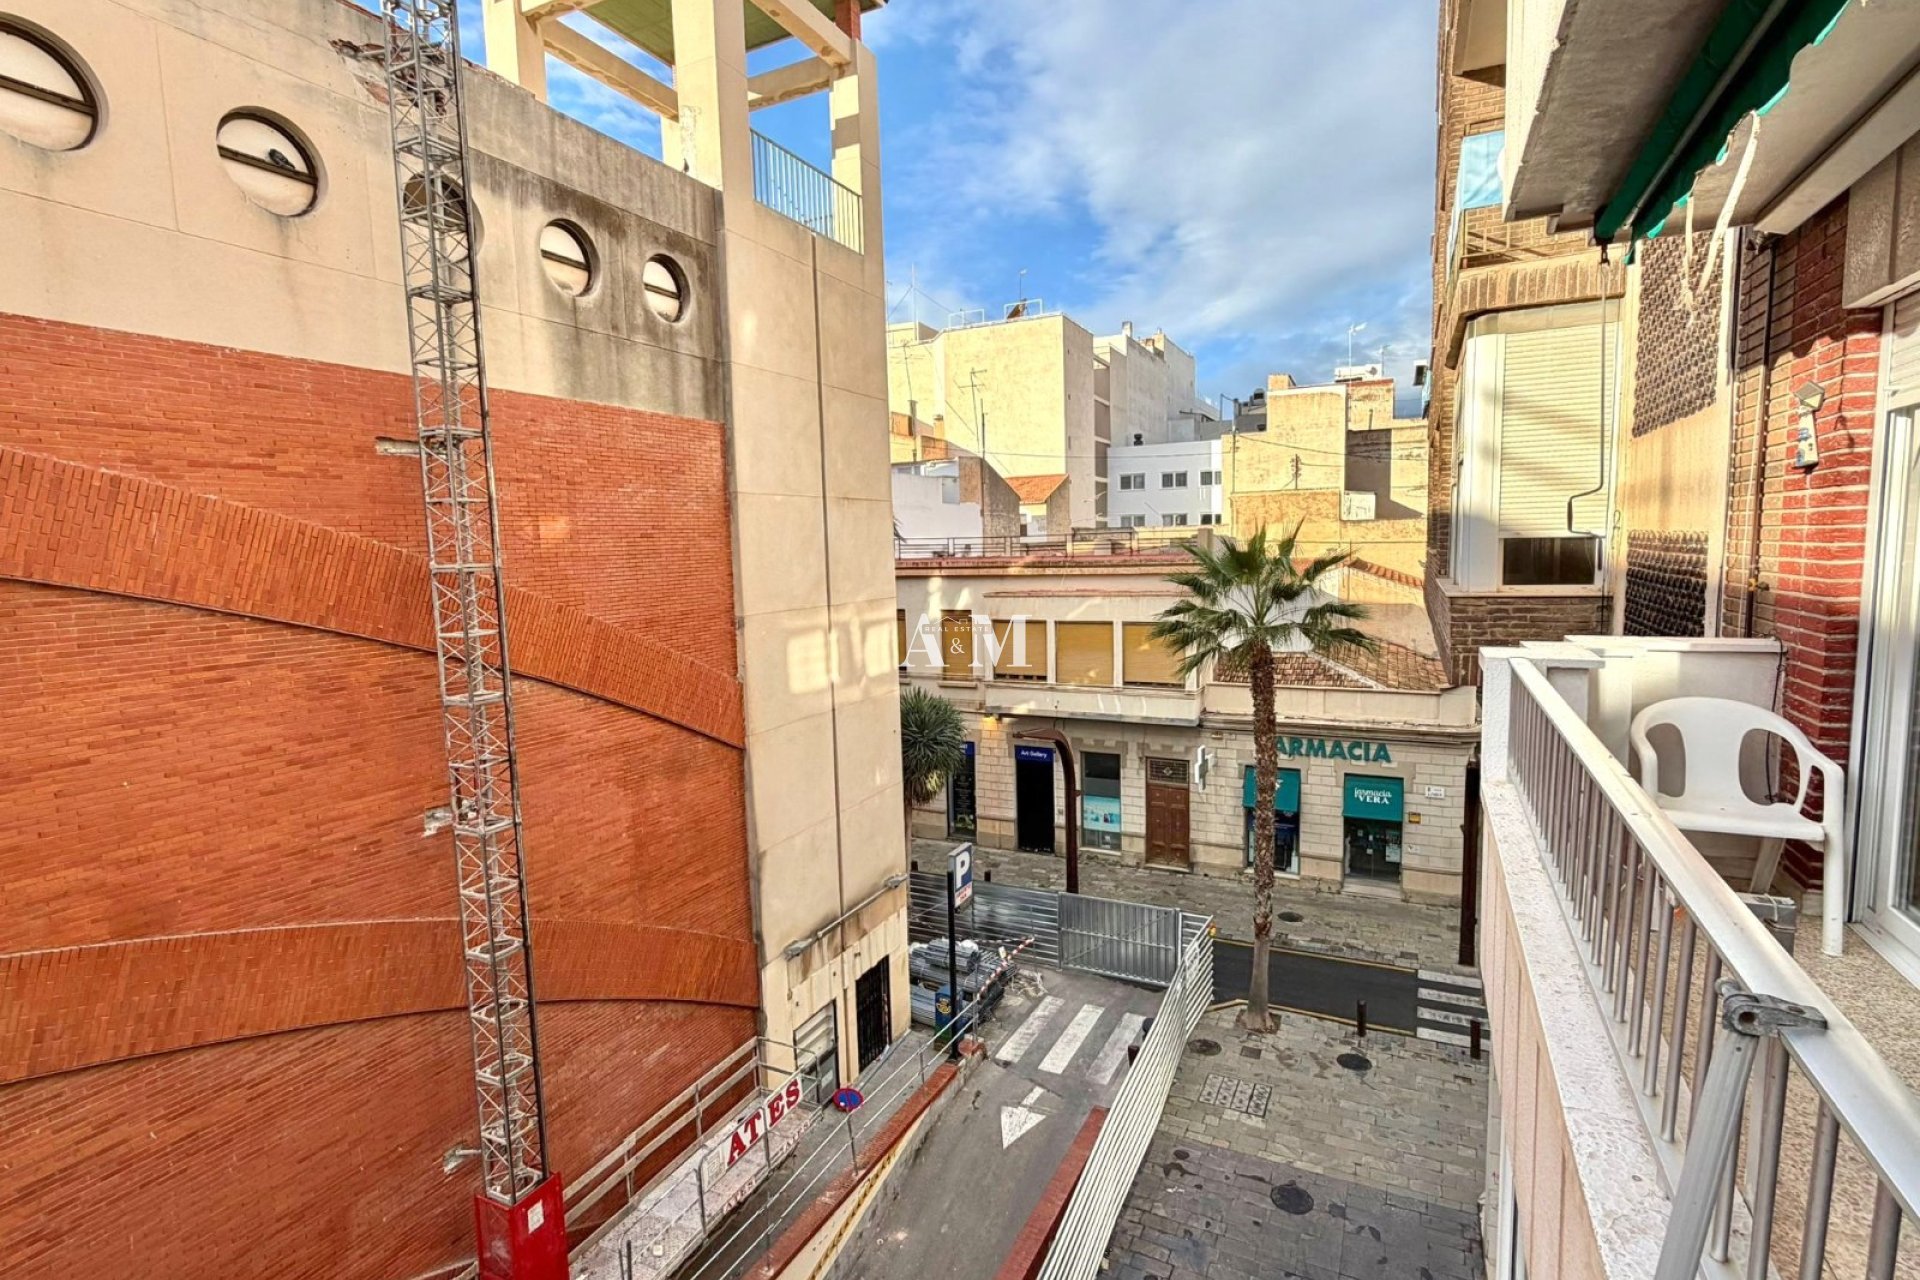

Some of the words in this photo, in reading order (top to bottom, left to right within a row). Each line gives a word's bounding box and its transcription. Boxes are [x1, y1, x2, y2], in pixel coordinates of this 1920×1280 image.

[1030, 751, 1047, 759] Gallery
[1274, 735, 1392, 763] ARMACIA
[1354, 787, 1392, 798] farmacia
[1359, 795, 1390, 804] VERA
[955, 851, 971, 889] P
[727, 1078, 801, 1167] ATES
